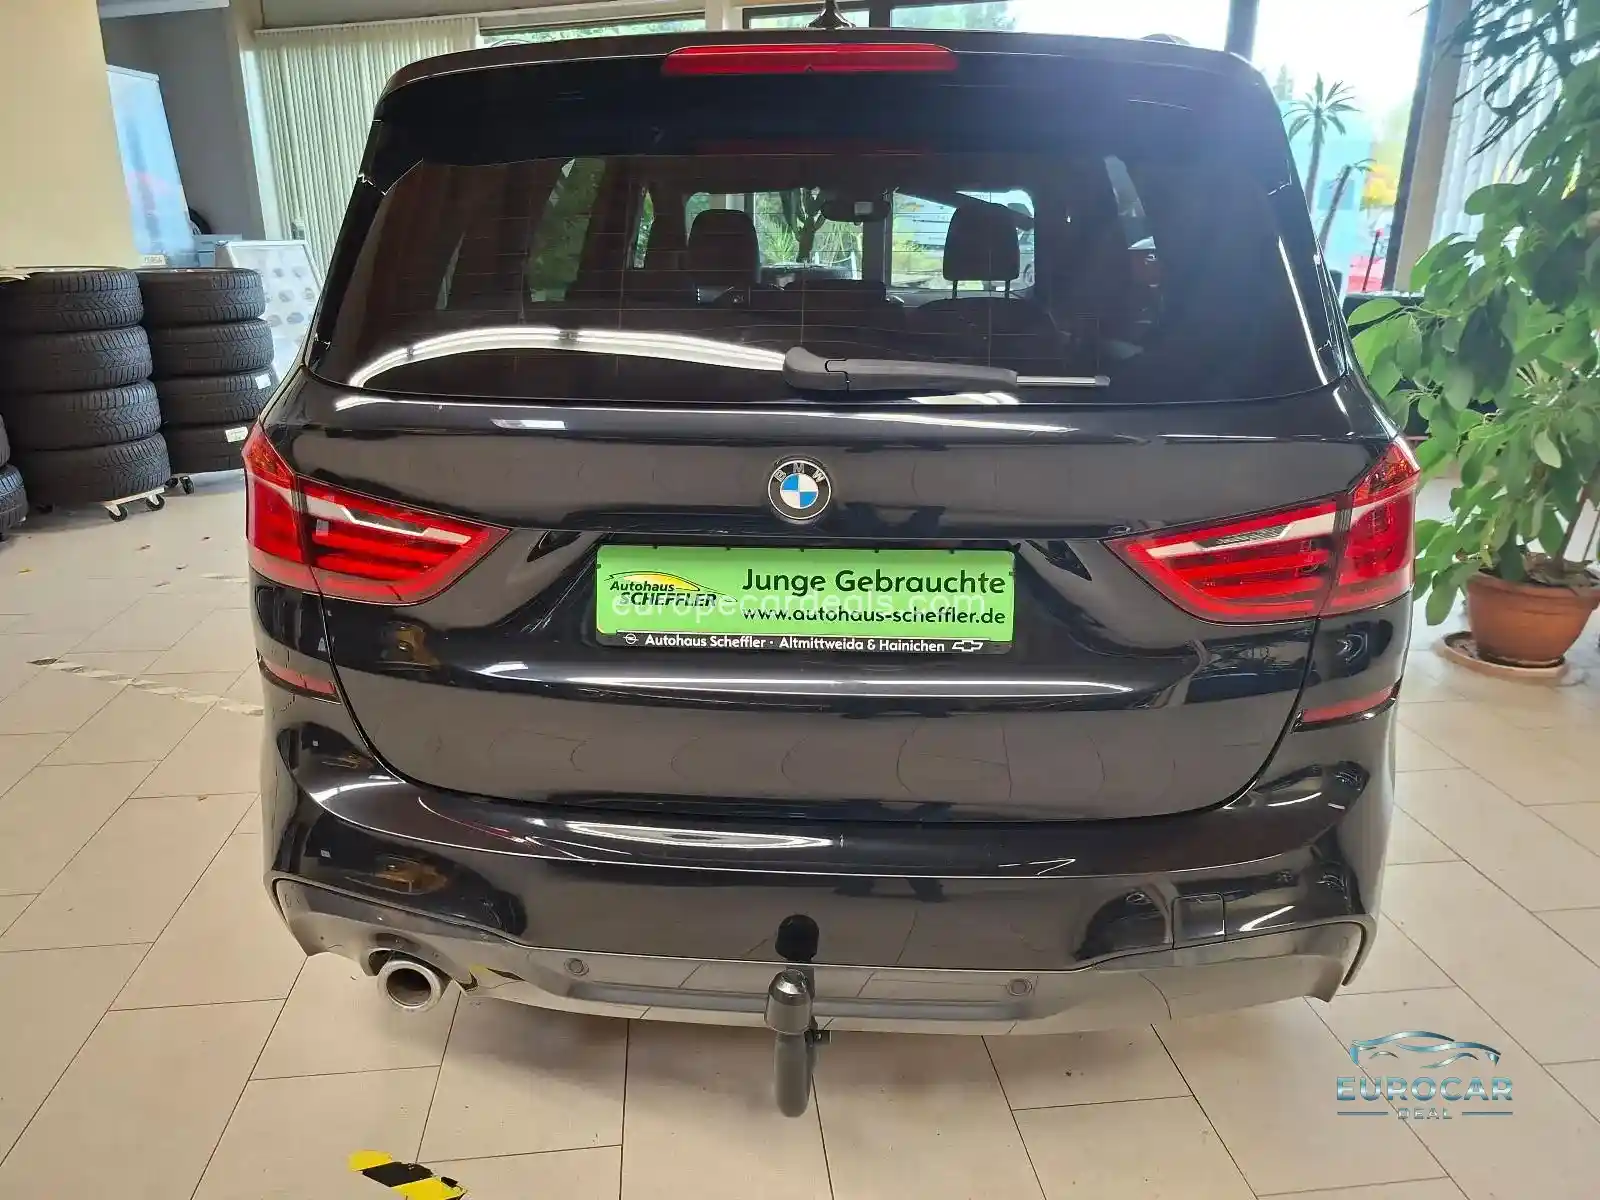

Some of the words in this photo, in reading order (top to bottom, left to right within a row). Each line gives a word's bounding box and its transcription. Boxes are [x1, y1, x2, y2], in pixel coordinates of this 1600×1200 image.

[773, 462, 826, 483] BMW
[609, 580, 675, 592] Autohaus
[742, 568, 826, 596] Junge
[836, 569, 1006, 594] Gebrauchte
[620, 591, 717, 607] SCHEFFLER
[743, 605, 1006, 624] www.autohaus-scheffler.de
[645, 634, 707, 647] Autohaus
[709, 635, 766, 649] Scheffler
[779, 637, 864, 651] Altmittweida
[867, 639, 876, 651] &
[879, 640, 945, 652] Hainichen
